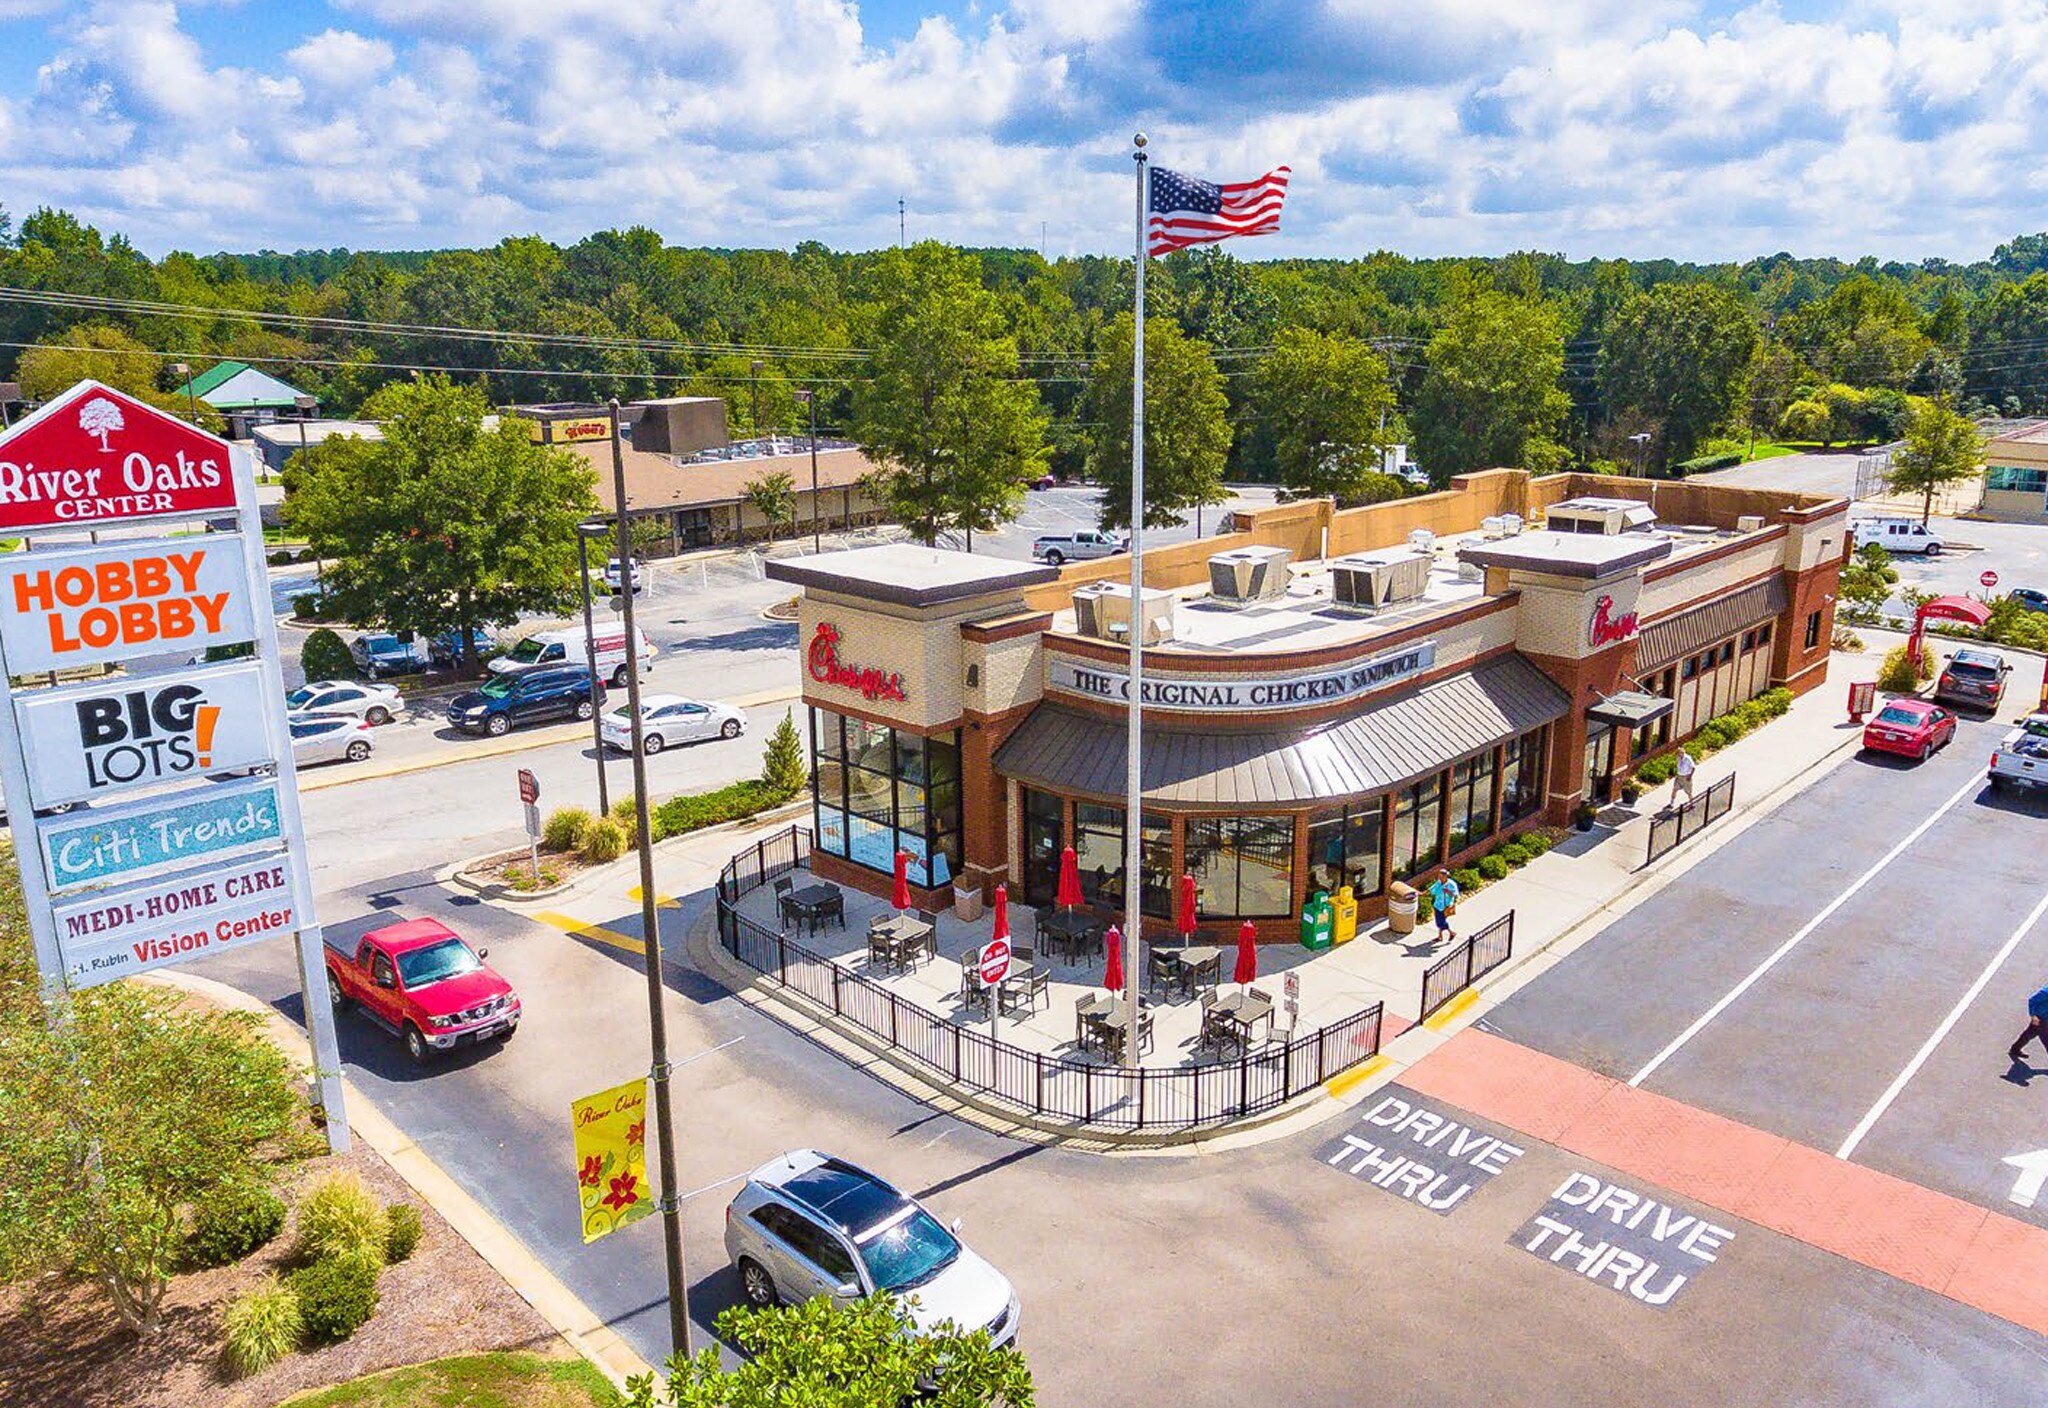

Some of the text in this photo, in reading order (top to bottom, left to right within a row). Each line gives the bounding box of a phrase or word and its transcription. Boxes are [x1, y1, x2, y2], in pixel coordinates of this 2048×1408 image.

[0, 450, 221, 503] River Oaks
[55, 492, 175, 519] CENTER
[13, 550, 206, 613] HOBBY
[48, 592, 230, 653] LOBBY
[1073, 669, 1112, 695] THE
[1250, 676, 1348, 705] CHICKEN
[1350, 652, 1421, 690] SANDWICH
[75, 684, 208, 749] BIG
[58, 802, 273, 874] Citi Trends
[66, 866, 286, 939] MEDI-HOME CARE
[91, 953, 129, 970] Rubin
[133, 928, 209, 963] Vision
[215, 907, 292, 942] Center
[578, 1094, 643, 1128] River Oaks
[1362, 1096, 1525, 1176] DRIVE
[1327, 1133, 1472, 1210] THRU
[1551, 1171, 1736, 1264] DRIVE
[1525, 1215, 1688, 1305] THRU
